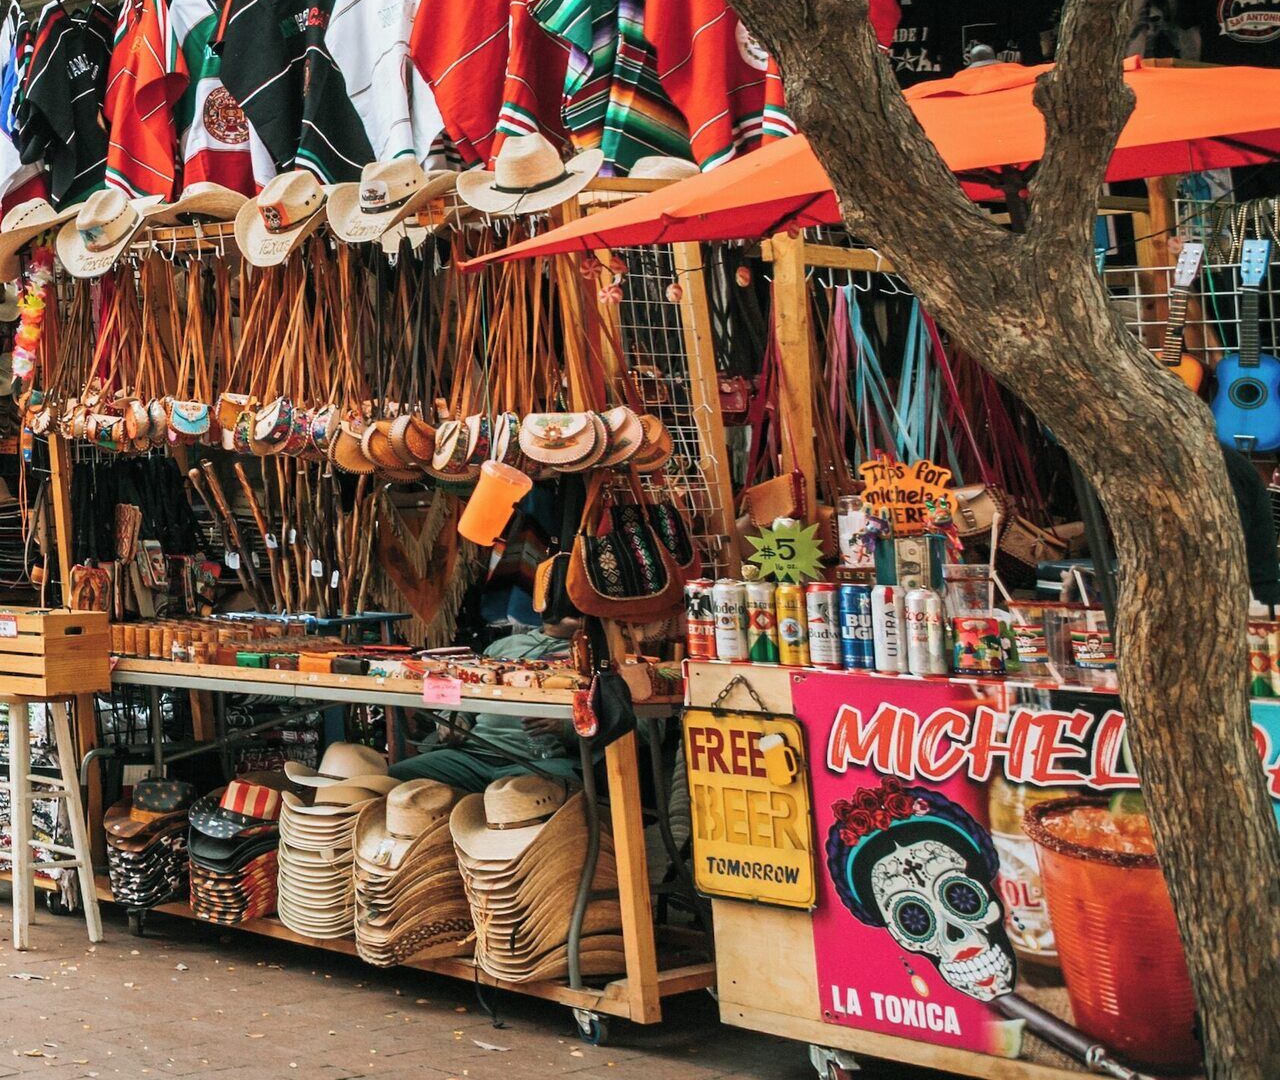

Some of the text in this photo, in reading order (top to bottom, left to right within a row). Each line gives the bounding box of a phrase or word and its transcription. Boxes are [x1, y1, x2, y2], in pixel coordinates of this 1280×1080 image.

[1246, 13, 1280, 23] ANTONI
[863, 461, 949, 486] Tips for
[688, 623, 715, 636] ECATE
[845, 613, 872, 627] BU
[884, 609, 898, 658] ULTRA
[688, 726, 768, 779] FREE
[693, 783, 807, 852] BEER
[706, 855, 800, 885] TOMORROW
[831, 984, 962, 1037] LA TOXICA
